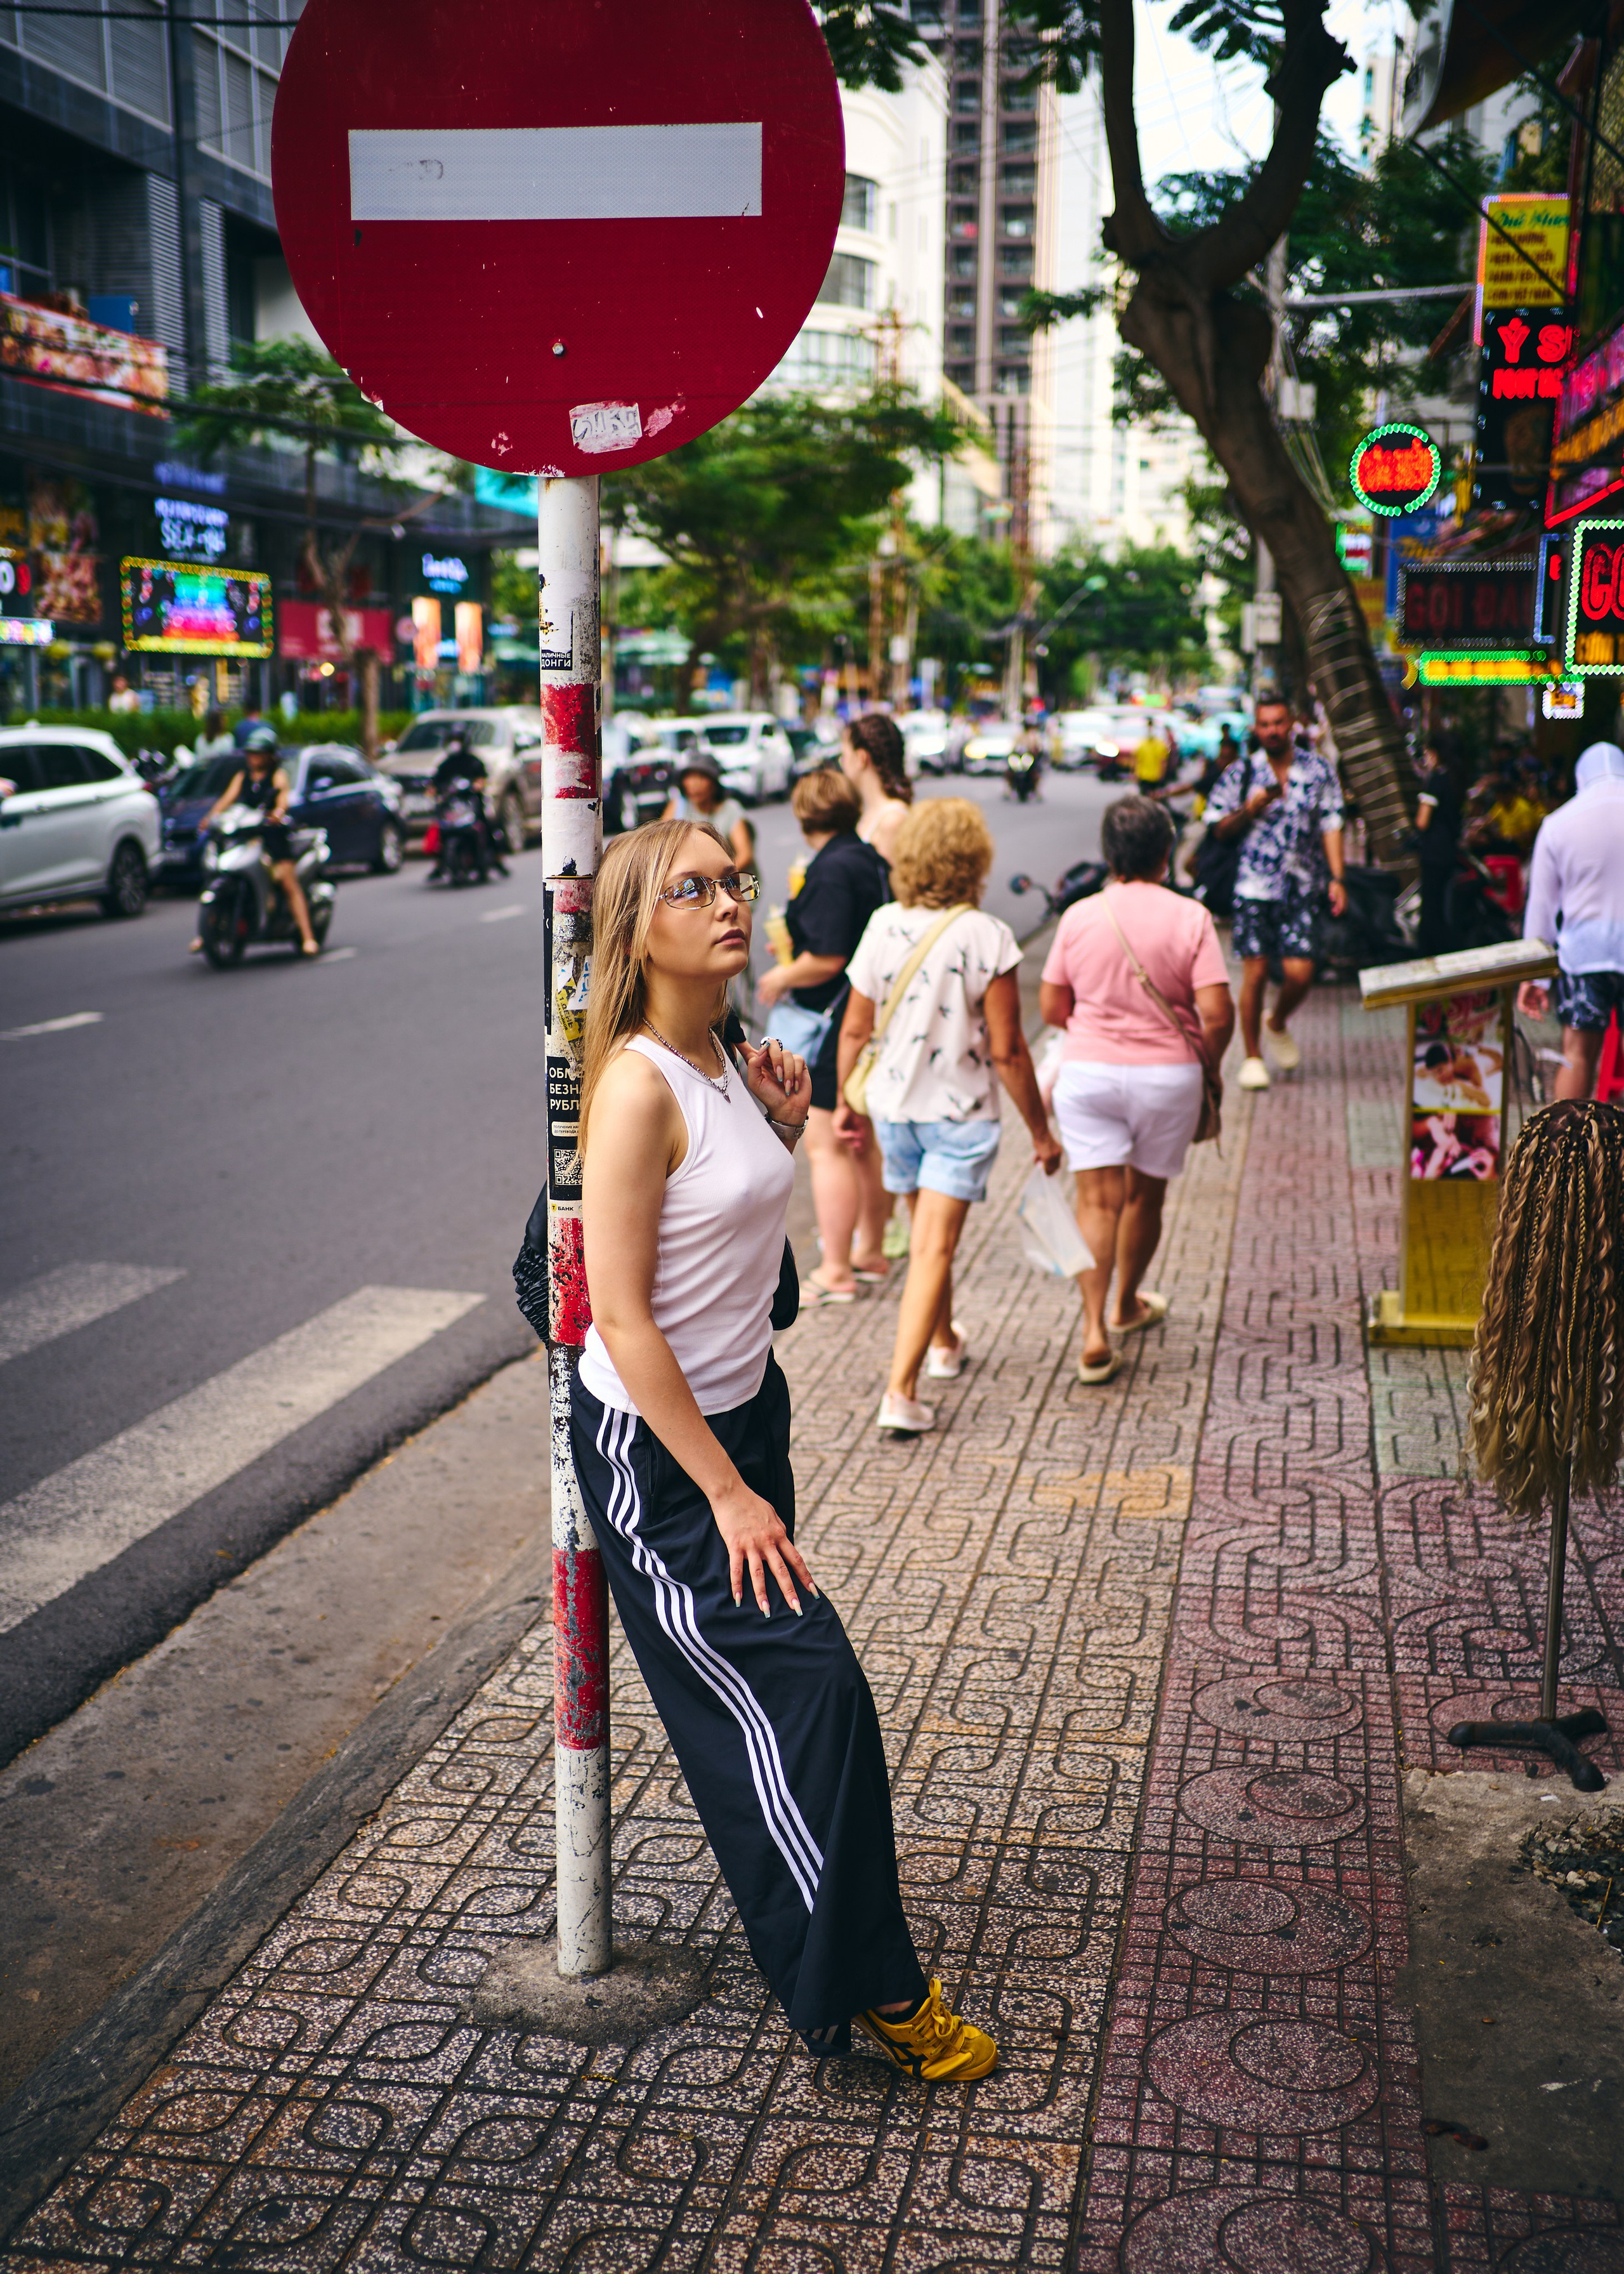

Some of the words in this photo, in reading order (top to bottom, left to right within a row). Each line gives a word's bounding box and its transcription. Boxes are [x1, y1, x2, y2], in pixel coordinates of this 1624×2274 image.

[1536, 324, 1573, 363] S
[541, 659, 571, 668] ДОНГИ
[549, 1083, 581, 1095] БЕЗН
[550, 1098, 580, 1110] РУБЛ
